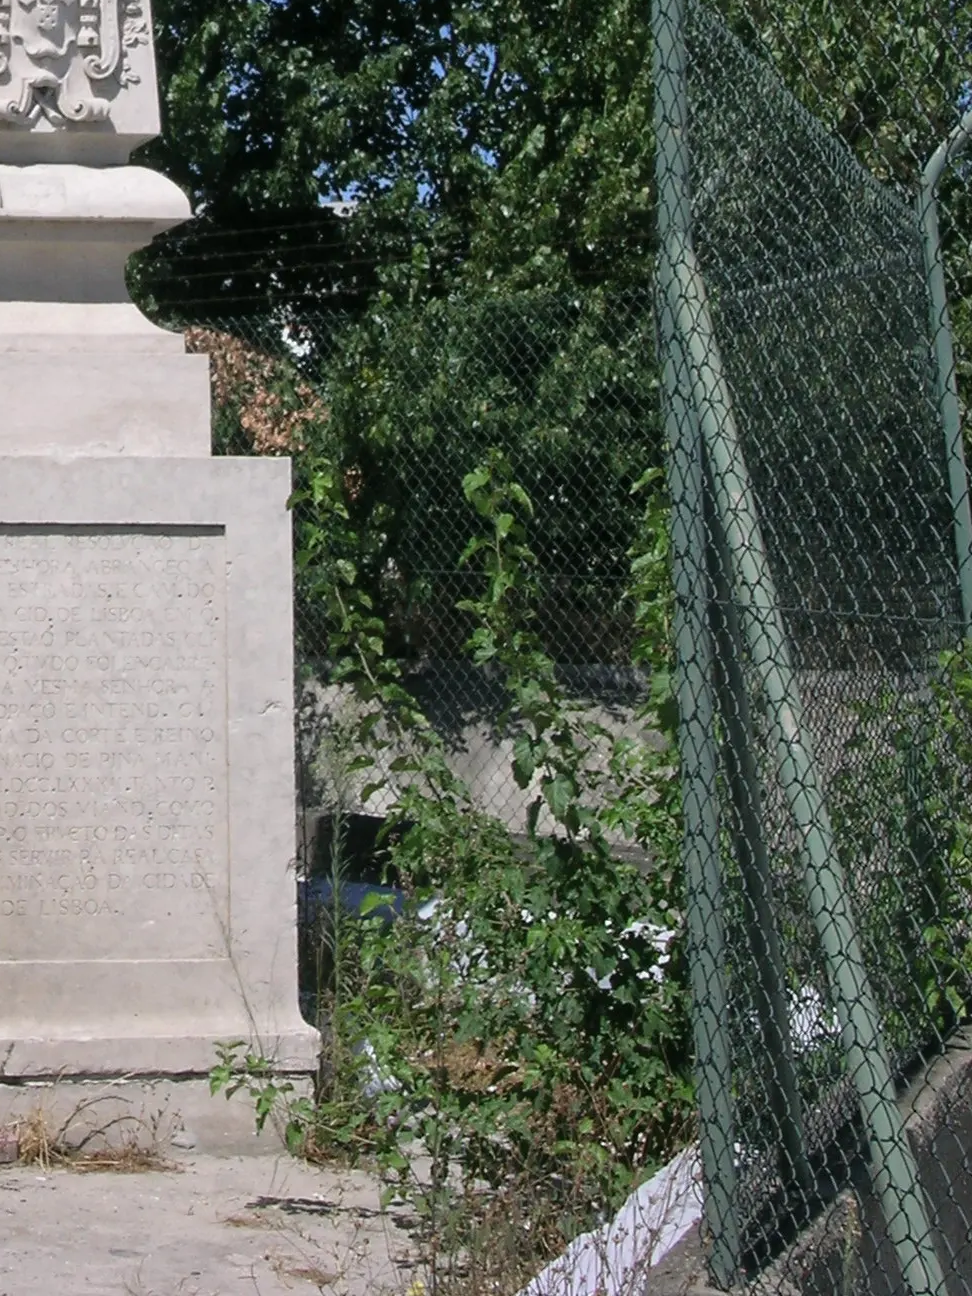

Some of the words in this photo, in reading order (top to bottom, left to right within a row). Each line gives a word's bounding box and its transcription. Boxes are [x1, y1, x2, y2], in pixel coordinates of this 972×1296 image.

[198, 559, 215, 574] A
[57, 607, 82, 622] DE
[90, 607, 155, 622] LISBOA
[101, 679, 189, 694] SENHORA
[66, 703, 78, 718] E
[26, 728, 54, 744] DA
[61, 728, 128, 744] CORTE
[134, 728, 147, 742] E
[154, 728, 215, 743] REINO
[65, 752, 90, 768] DE
[99, 752, 145, 768] PINA
[27, 802, 68, 818] DOS
[156, 801, 215, 816] COMO
[114, 825, 152, 840] DAS
[114, 849, 164, 864] REAL
[108, 873, 131, 889] DA
[143, 873, 216, 889] CIDADE
[1, 900, 27, 916] DE
